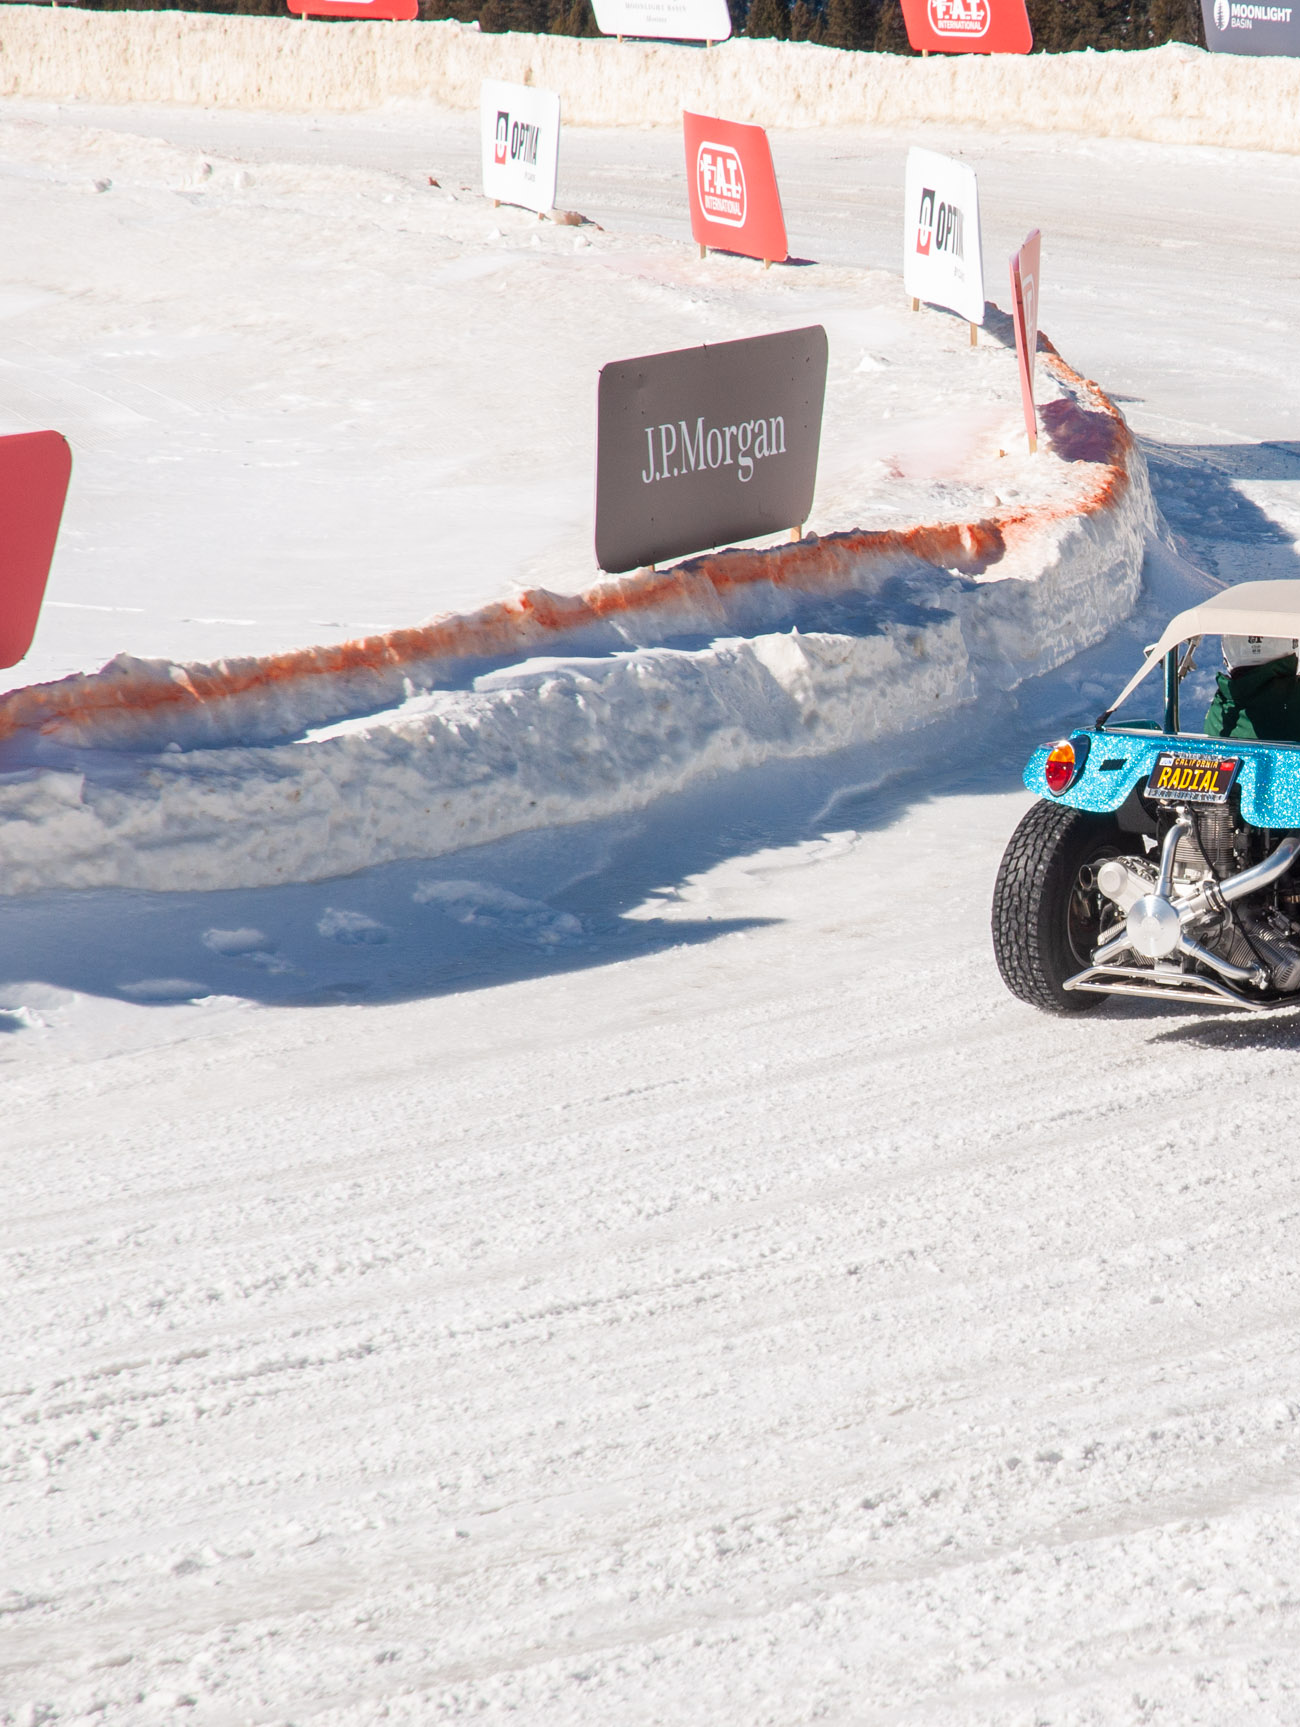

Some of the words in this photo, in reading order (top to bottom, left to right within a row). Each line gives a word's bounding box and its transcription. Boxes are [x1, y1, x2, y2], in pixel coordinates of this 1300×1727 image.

[1231, 3, 1293, 22] MOONLIGHT
[937, 20, 983, 30] INTERNATIONAL
[1231, 17, 1252, 30] BASIN
[704, 194, 742, 217] INTERNATIONAL
[641, 415, 787, 484] J.P.Morgan
[1174, 758, 1219, 769] CALIFORNIA
[1157, 766, 1220, 792] RADIAL
